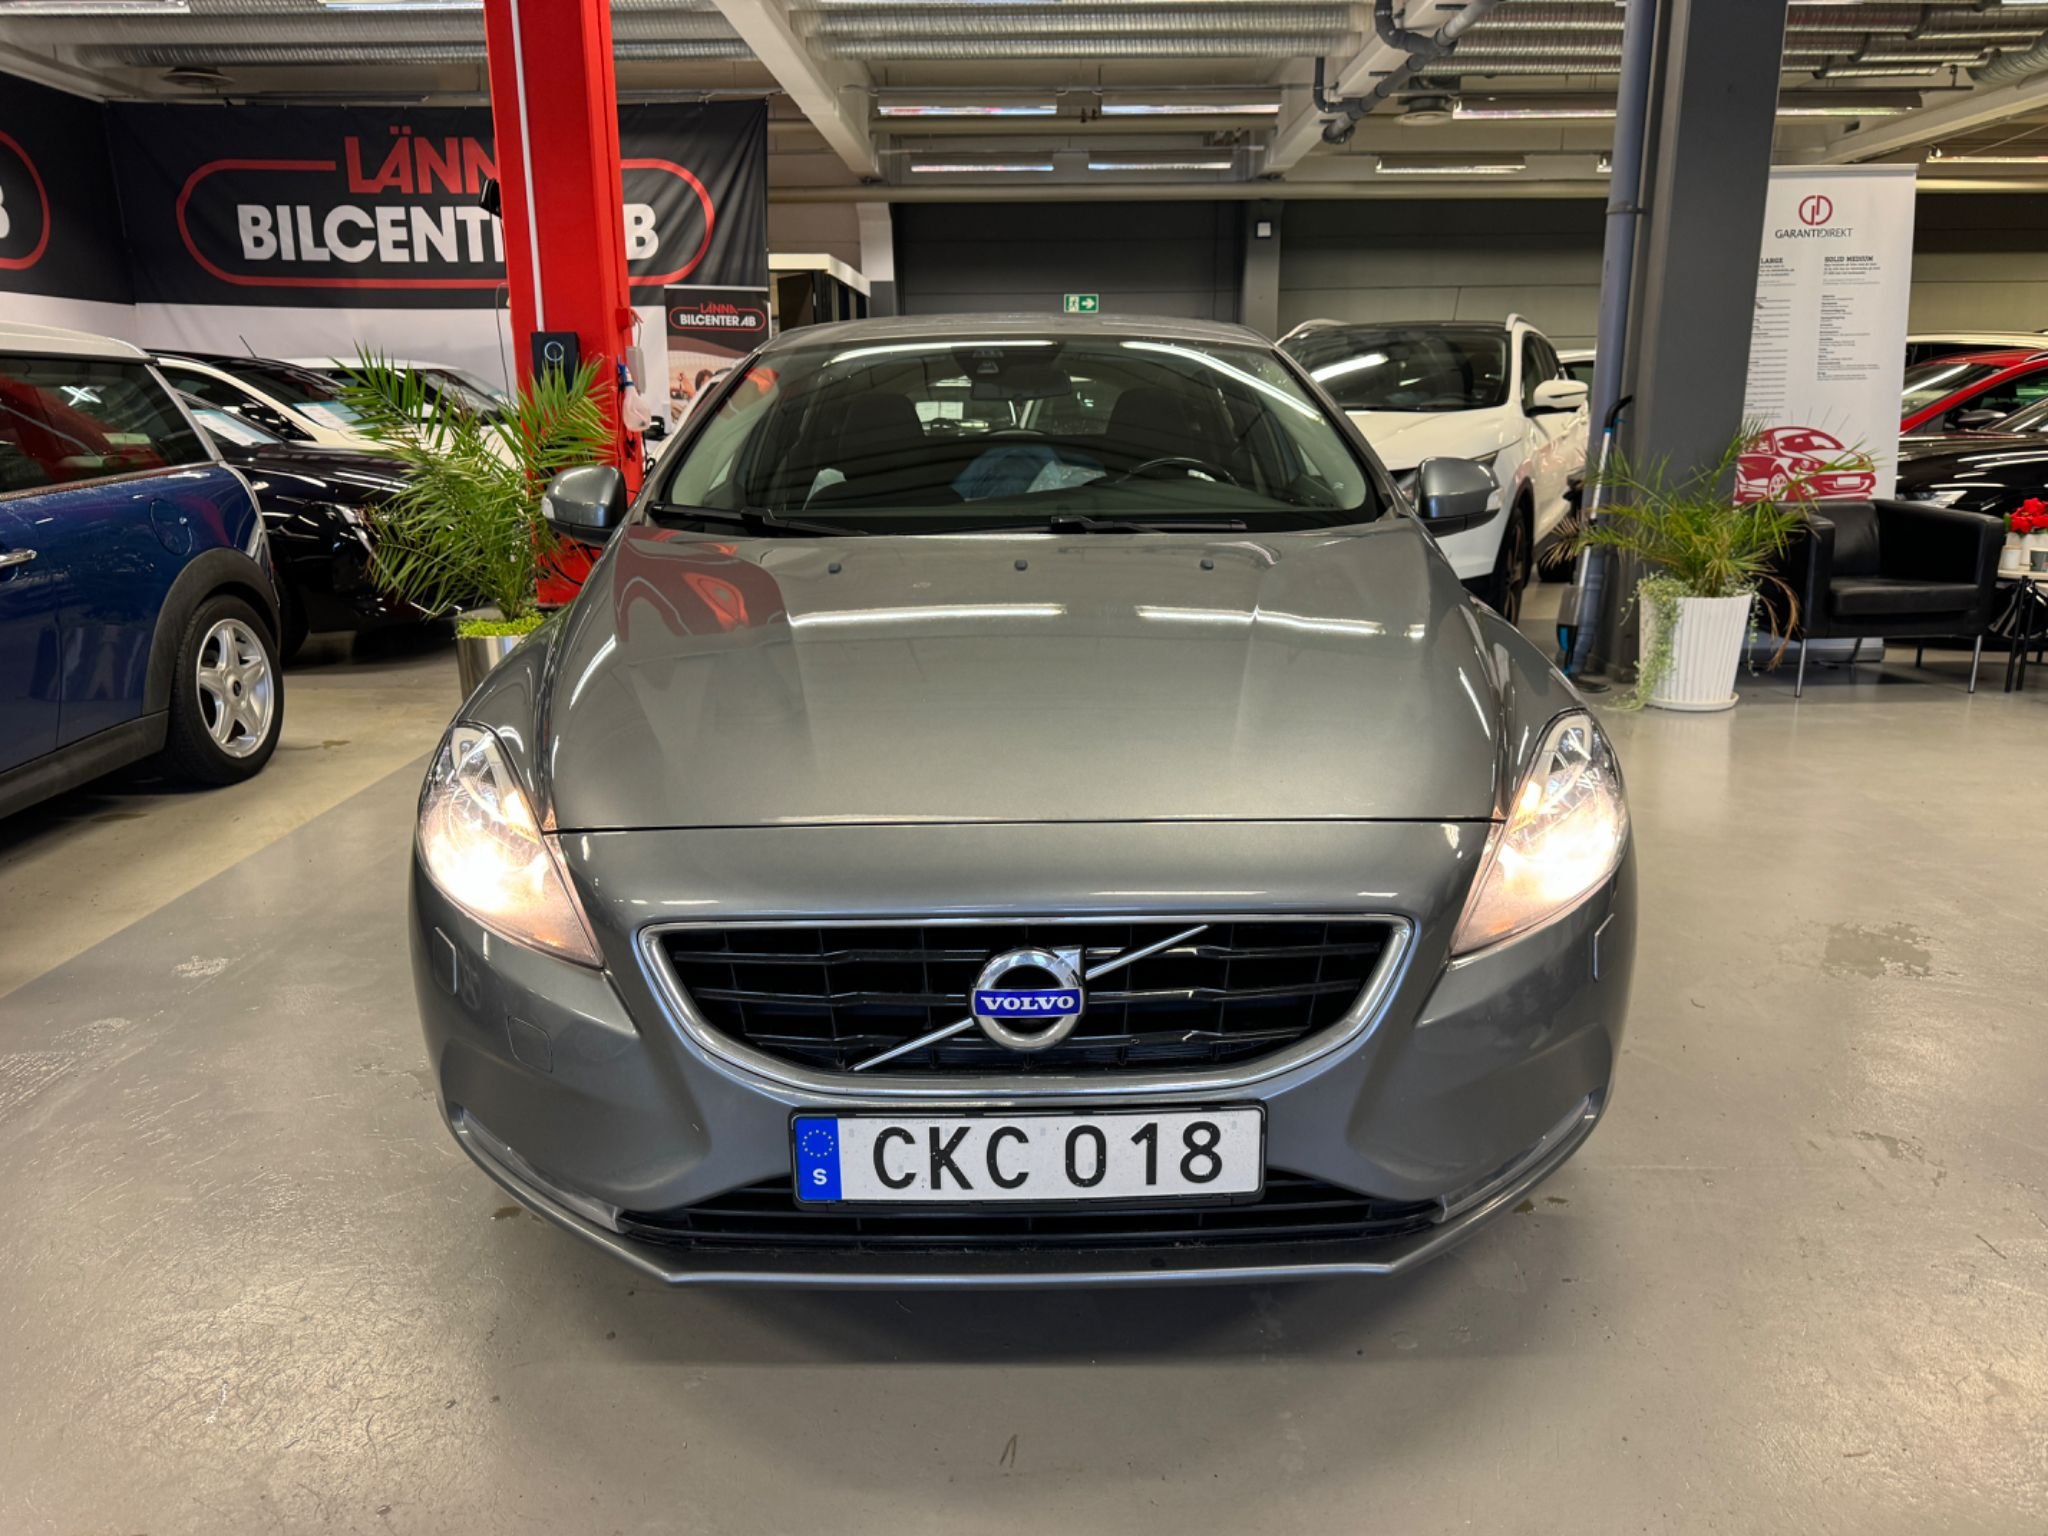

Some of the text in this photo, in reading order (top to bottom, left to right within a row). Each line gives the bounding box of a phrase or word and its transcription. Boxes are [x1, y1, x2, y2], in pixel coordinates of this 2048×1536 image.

[345, 126, 498, 193] LÄNN
[237, 203, 660, 262] BILCENT B
[1775, 228, 1853, 239] GARANTIDIREKT
[700, 303, 738, 313] LÄNNA
[680, 314, 756, 327] BILCENTER AB
[981, 996, 1075, 1010] VOLVO
[873, 1121, 1223, 1190] CKC 018
[813, 1168, 828, 1185] S
